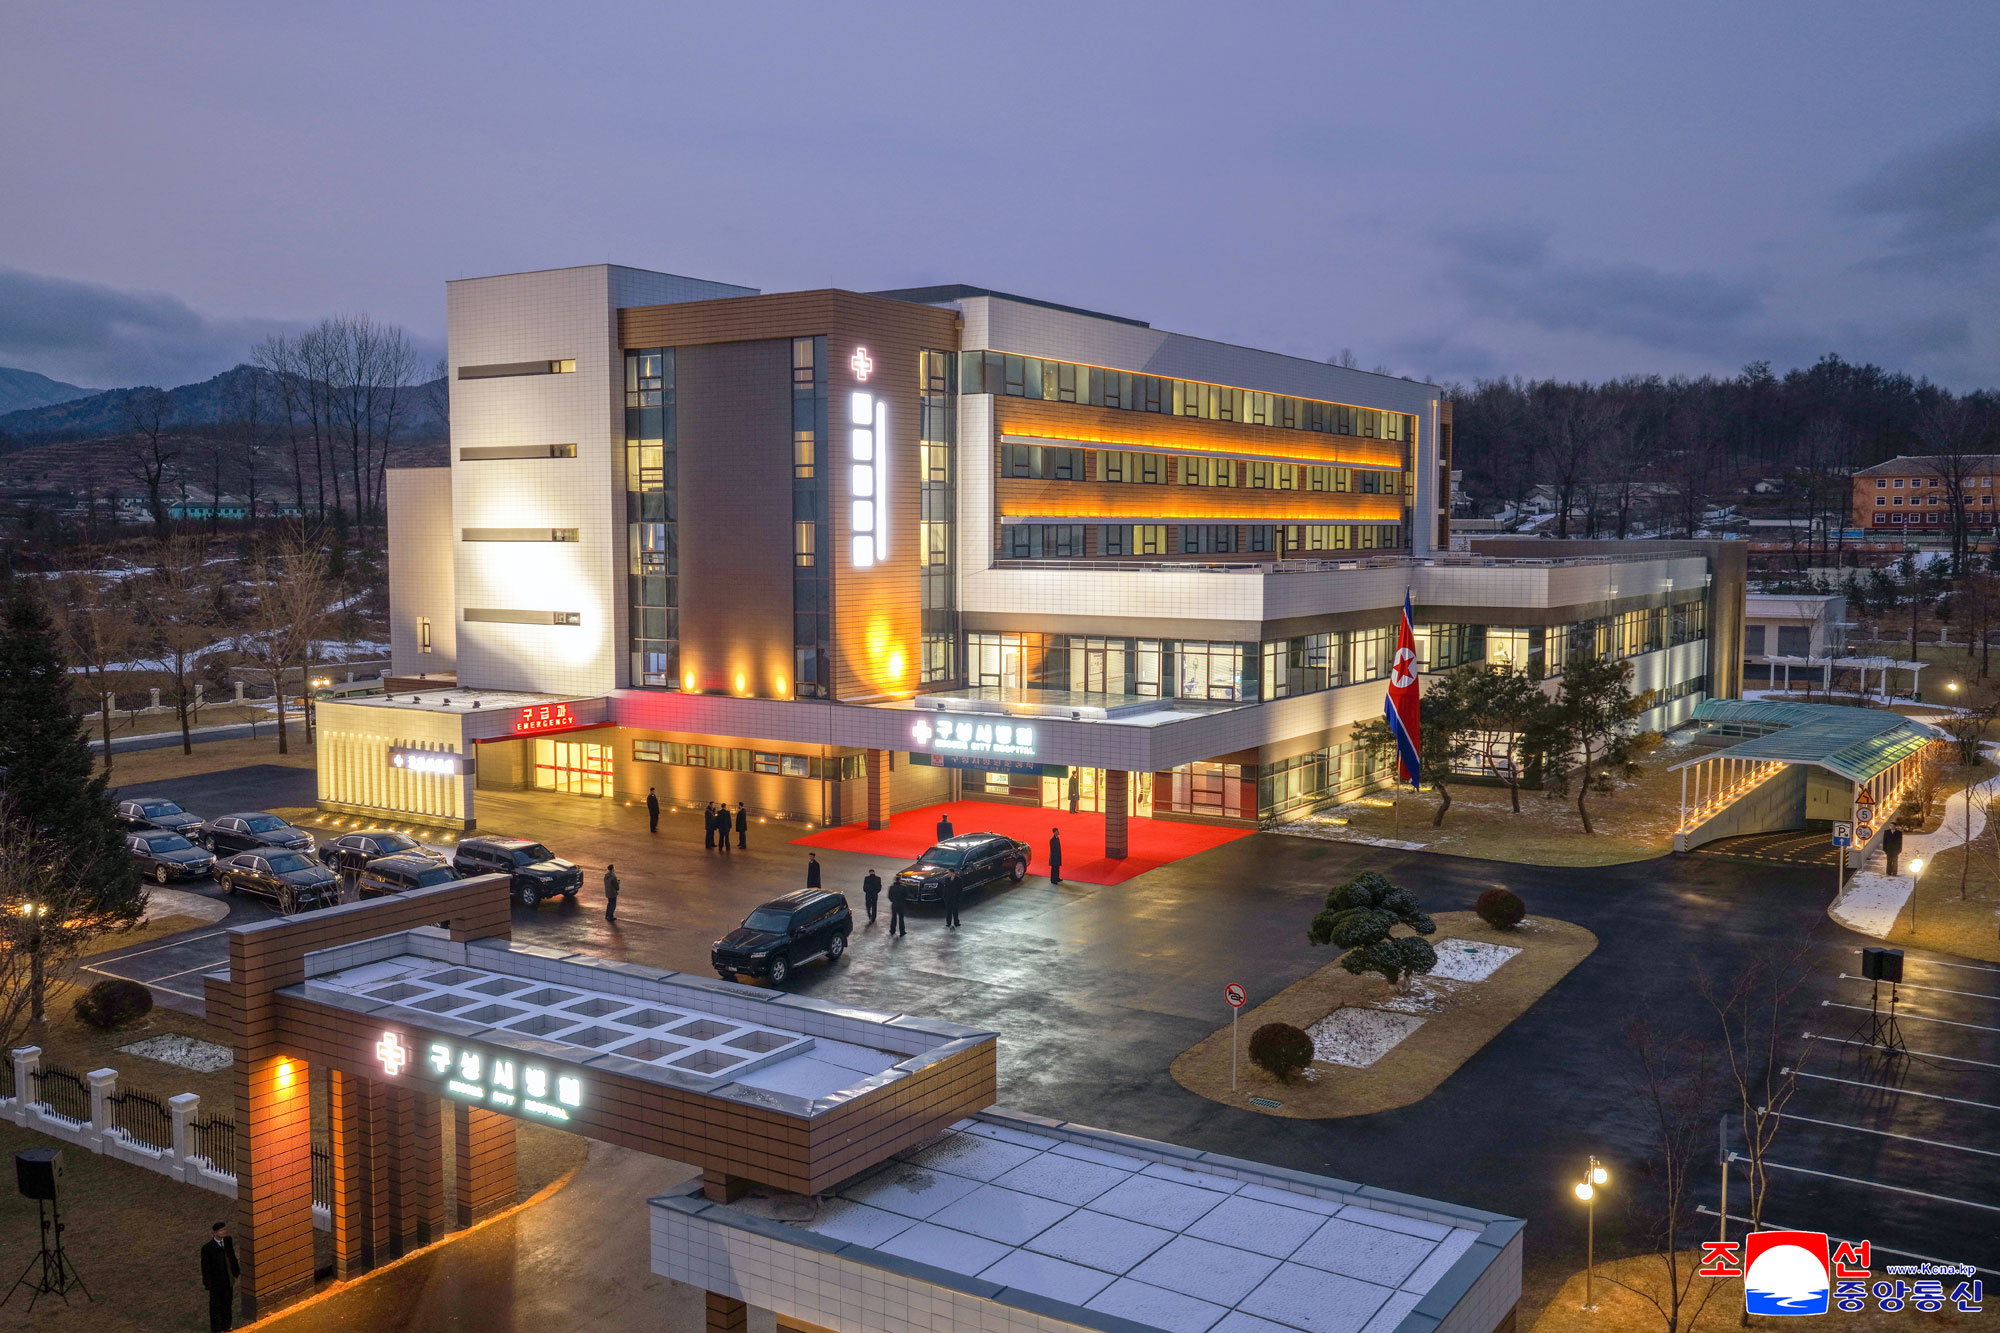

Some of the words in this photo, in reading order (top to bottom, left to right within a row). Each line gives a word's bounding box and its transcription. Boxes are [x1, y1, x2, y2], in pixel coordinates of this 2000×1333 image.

[523, 705, 567, 721] 구급과
[517, 717, 573, 730] EMERGENCY
[1861, 810, 1868, 819] 5
[1838, 827, 1846, 837] P
